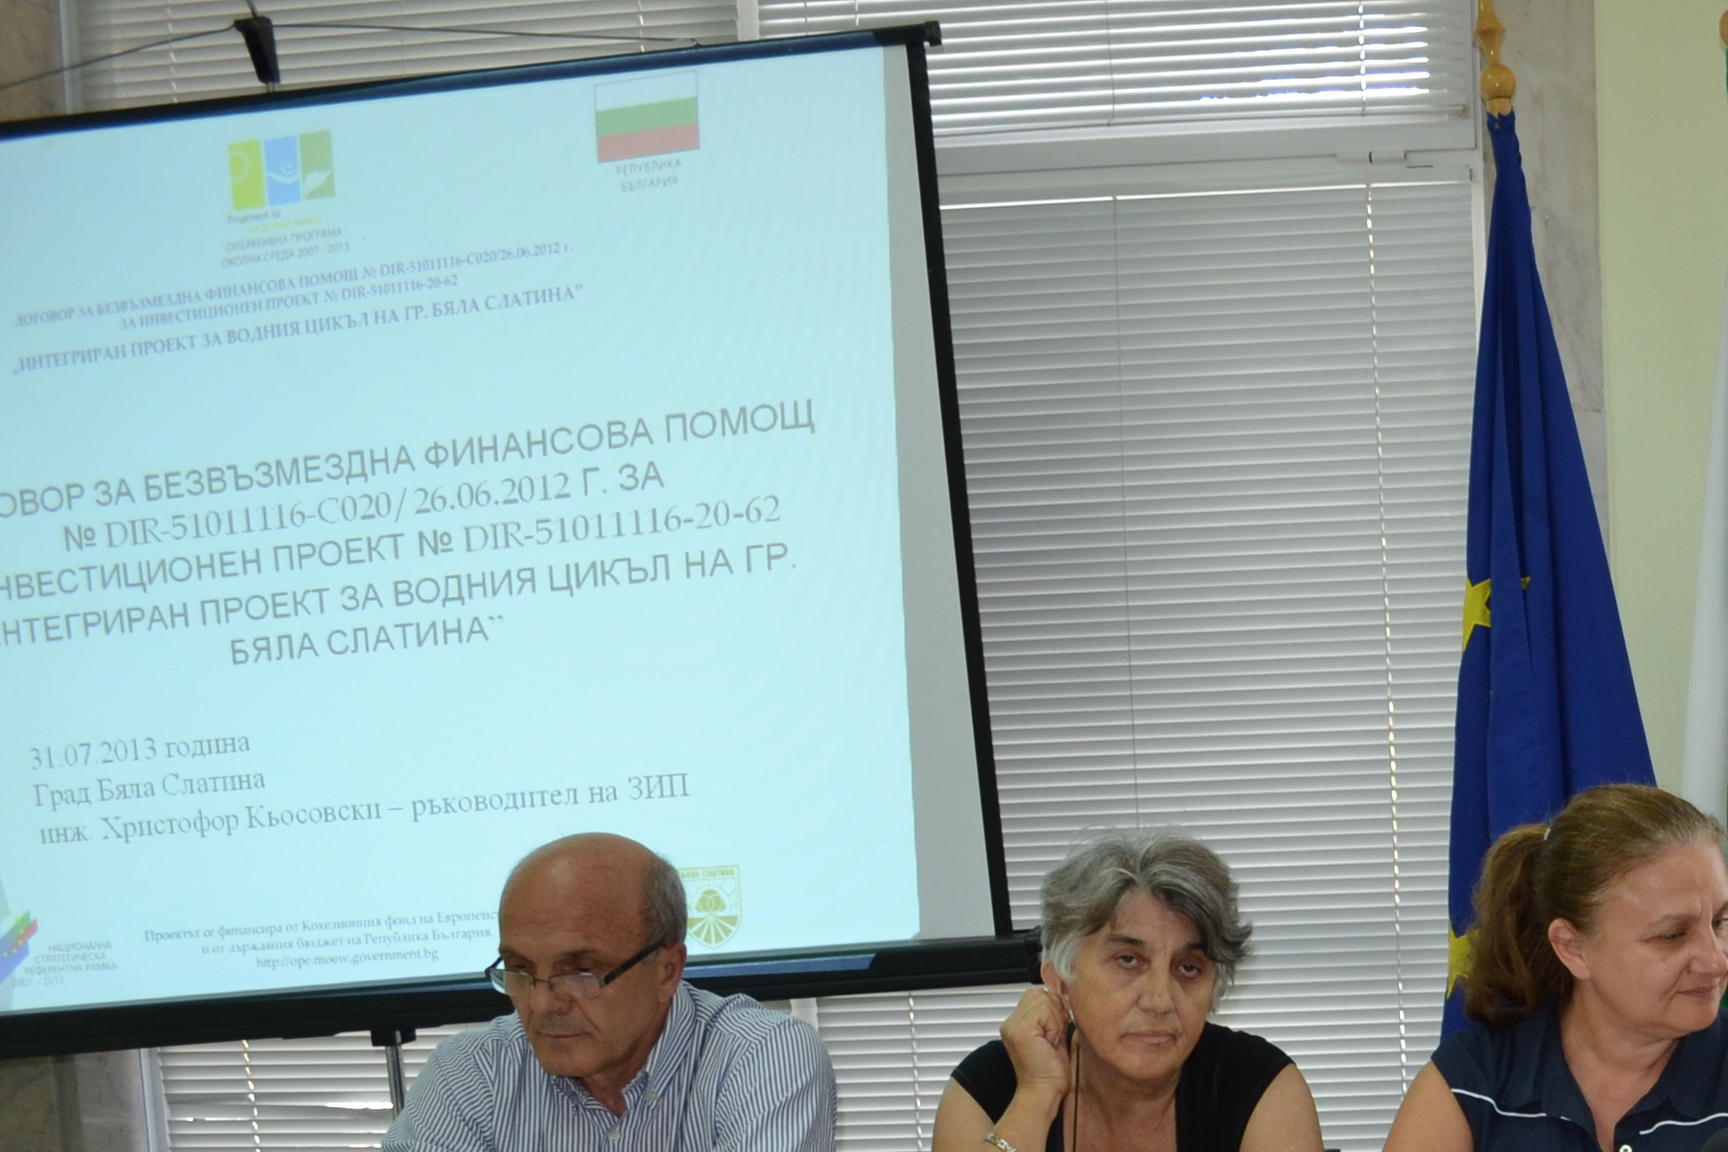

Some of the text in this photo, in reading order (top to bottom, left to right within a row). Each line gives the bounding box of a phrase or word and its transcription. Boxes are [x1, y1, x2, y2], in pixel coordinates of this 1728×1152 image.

[615, 158, 682, 176] РЕПУБЛИКА
[621, 174, 679, 193] БЪЛГАРИЯ
[222, 252, 262, 268] ОКОЛНА
[264, 248, 294, 263] СРЕДА
[226, 227, 342, 253] ОПЕРАТИВНА ПРОГРАМА
[14, 306, 75, 328] ДОГОВОР
[78, 303, 95, 319] ЗА
[97, 292, 201, 316] БЕЗВЪЗМЕЗДНА
[205, 277, 296, 300] ФИНАНСОВА
[299, 267, 359, 288] ПОМОЩ
[120, 315, 137, 331] ЗА
[139, 300, 263, 328] ИНВЕСТИЦИОНЕН
[265, 291, 320, 313] ПРОЕКТ
[131, 334, 197, 357] ПРОЕКТ
[202, 331, 223, 349] ЗА
[226, 321, 301, 347] ВОДНИЯ
[304, 310, 370, 338] ЦИКЪЛ
[373, 308, 400, 327] НА
[403, 302, 429, 323] ГР.
[430, 296, 481, 321] БЯЛА
[94, 478, 136, 507] ЗА
[144, 443, 417, 502] БЕЗВЪЗМЕЗДНА
[424, 416, 655, 469] ФИНАНСОВА
[664, 398, 816, 446] ПОМОЩ
[63, 523, 97, 552] №
[581, 466, 608, 497] Г.
[618, 460, 666, 492] ЗА
[273, 532, 405, 572] ПРОЕКТ
[418, 528, 454, 558] №
[464, 494, 782, 554] DIR-51011116-20-62
[0, 541, 798, 648] НТЕГРИРАН ПРОЕКТ ЗА ВОДНИЯ ЦИКЪЛ НА ГР.
[230, 632, 320, 667] БЯЛА
[30, 735, 251, 771] 31.07.2013 година
[33, 770, 267, 811] Град Бяла Слатина
[40, 772, 691, 845] инж. Христофор Кьосовски ръководител на ЗИП
[144, 910, 499, 945] Проектът се финансира от Кохезионния фонд на Европейс
[228, 940, 294, 957] държавния
[346, 936, 362, 947] на
[364, 930, 429, 946] Република
